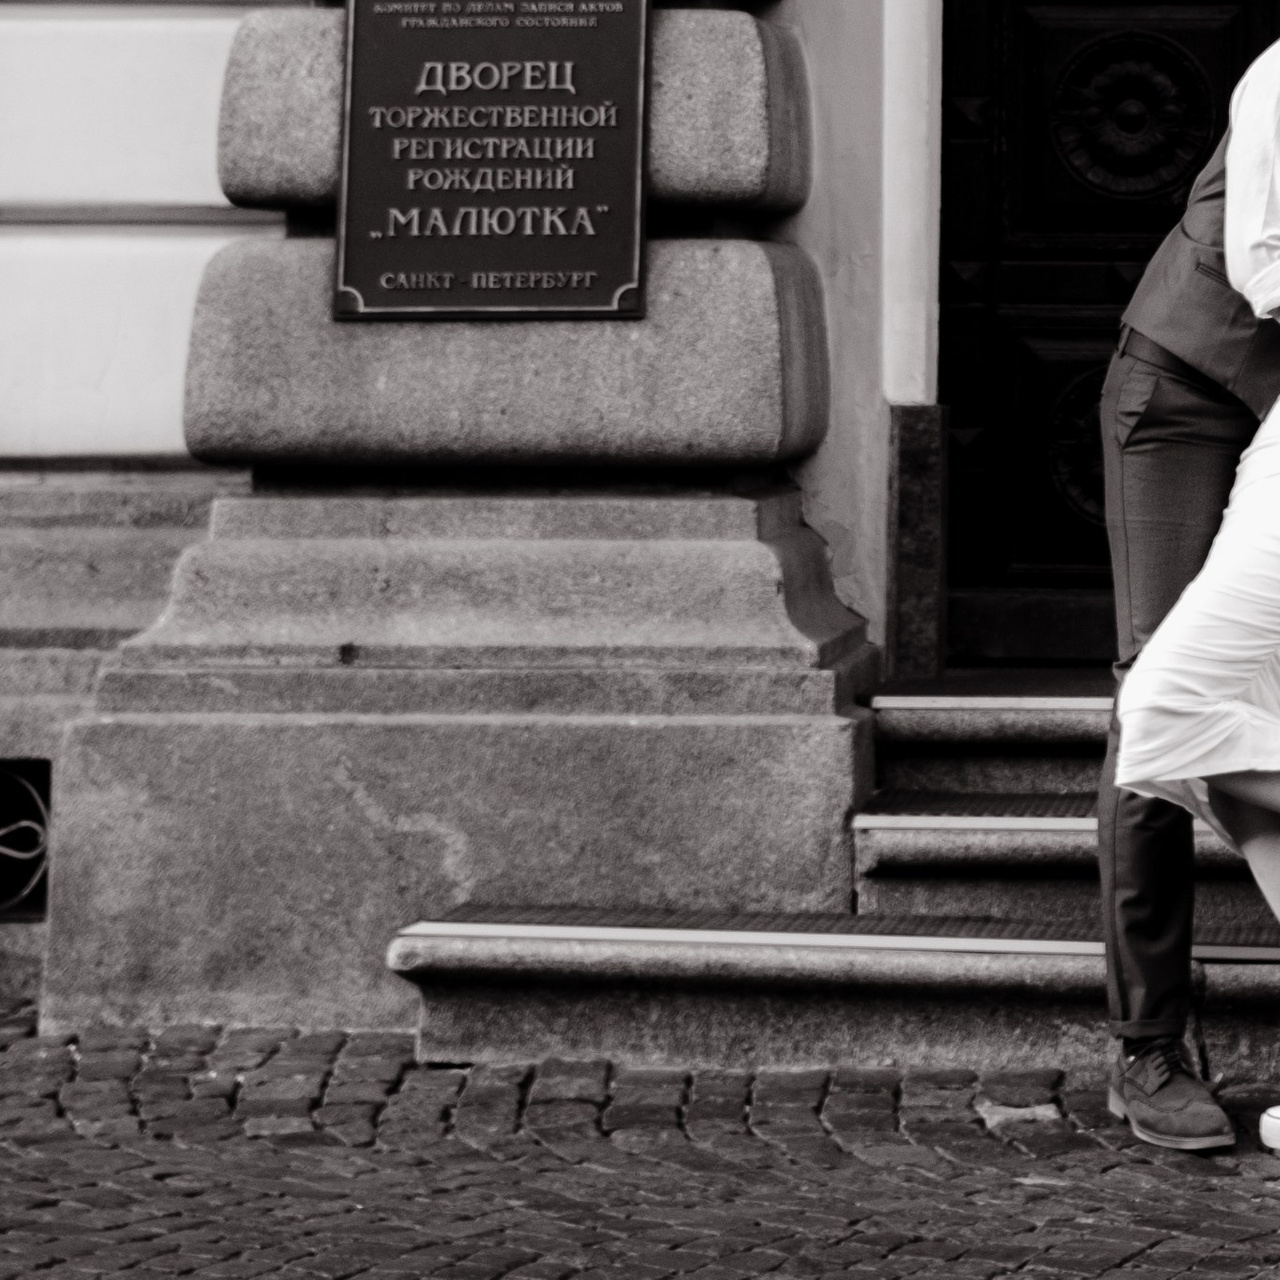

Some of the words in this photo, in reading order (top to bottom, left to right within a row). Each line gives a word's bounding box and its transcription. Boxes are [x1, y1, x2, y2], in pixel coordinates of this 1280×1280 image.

[373, 3, 436, 13] КОМИТЕТ
[442, 3, 461, 13] ПО
[465, 2, 514, 14] ДЕЛАМ
[520, 2, 574, 12] ЗАПИСИ
[579, 2, 623, 12] АКТОВ
[401, 17, 510, 29] ГРАЖДАНСКОГО
[516, 17, 597, 27] СОСТОЯНИЯ
[415, 61, 575, 94] ДВОРЕЦ
[369, 101, 618, 128] ТОРЖЕСТВЕННОЙ
[393, 138, 594, 162] РЕГИСТРАЦИИ
[407, 163, 574, 192] РОЖДЕНИЙ
